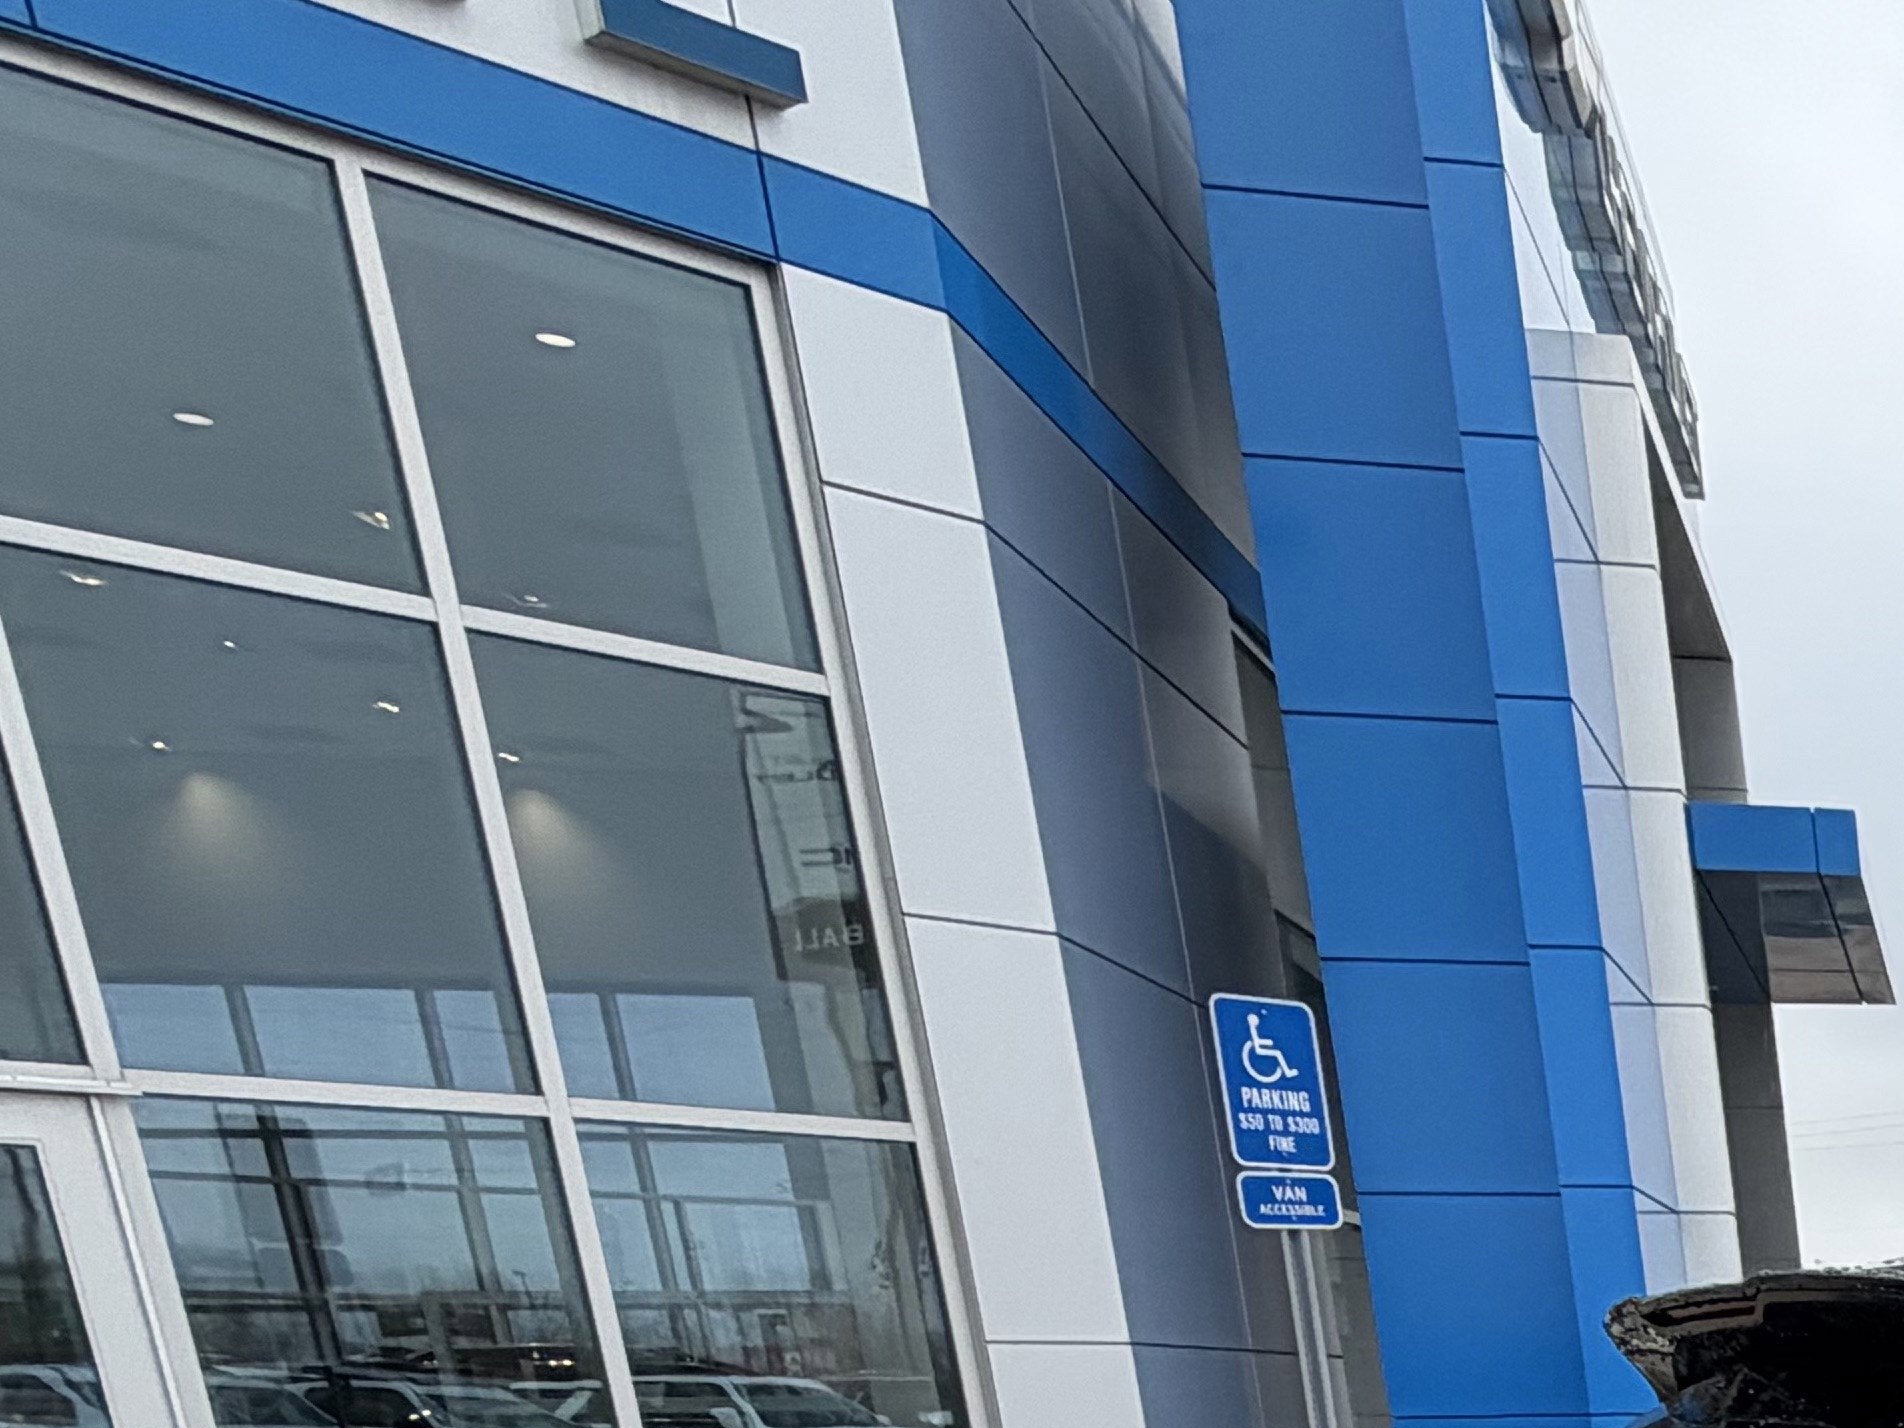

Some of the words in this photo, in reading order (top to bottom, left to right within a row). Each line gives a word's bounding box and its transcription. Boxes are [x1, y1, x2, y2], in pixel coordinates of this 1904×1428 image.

[1241, 1086, 1311, 1112] PARKING
[1239, 1112, 1264, 1130] $50
[1267, 1114, 1283, 1131] TO
[1287, 1116, 1319, 1134] $300
[1268, 1135, 1297, 1153] FINE
[1271, 1185, 1307, 1202] VAN
[1260, 1203, 1326, 1217] ACCESSIBLE
